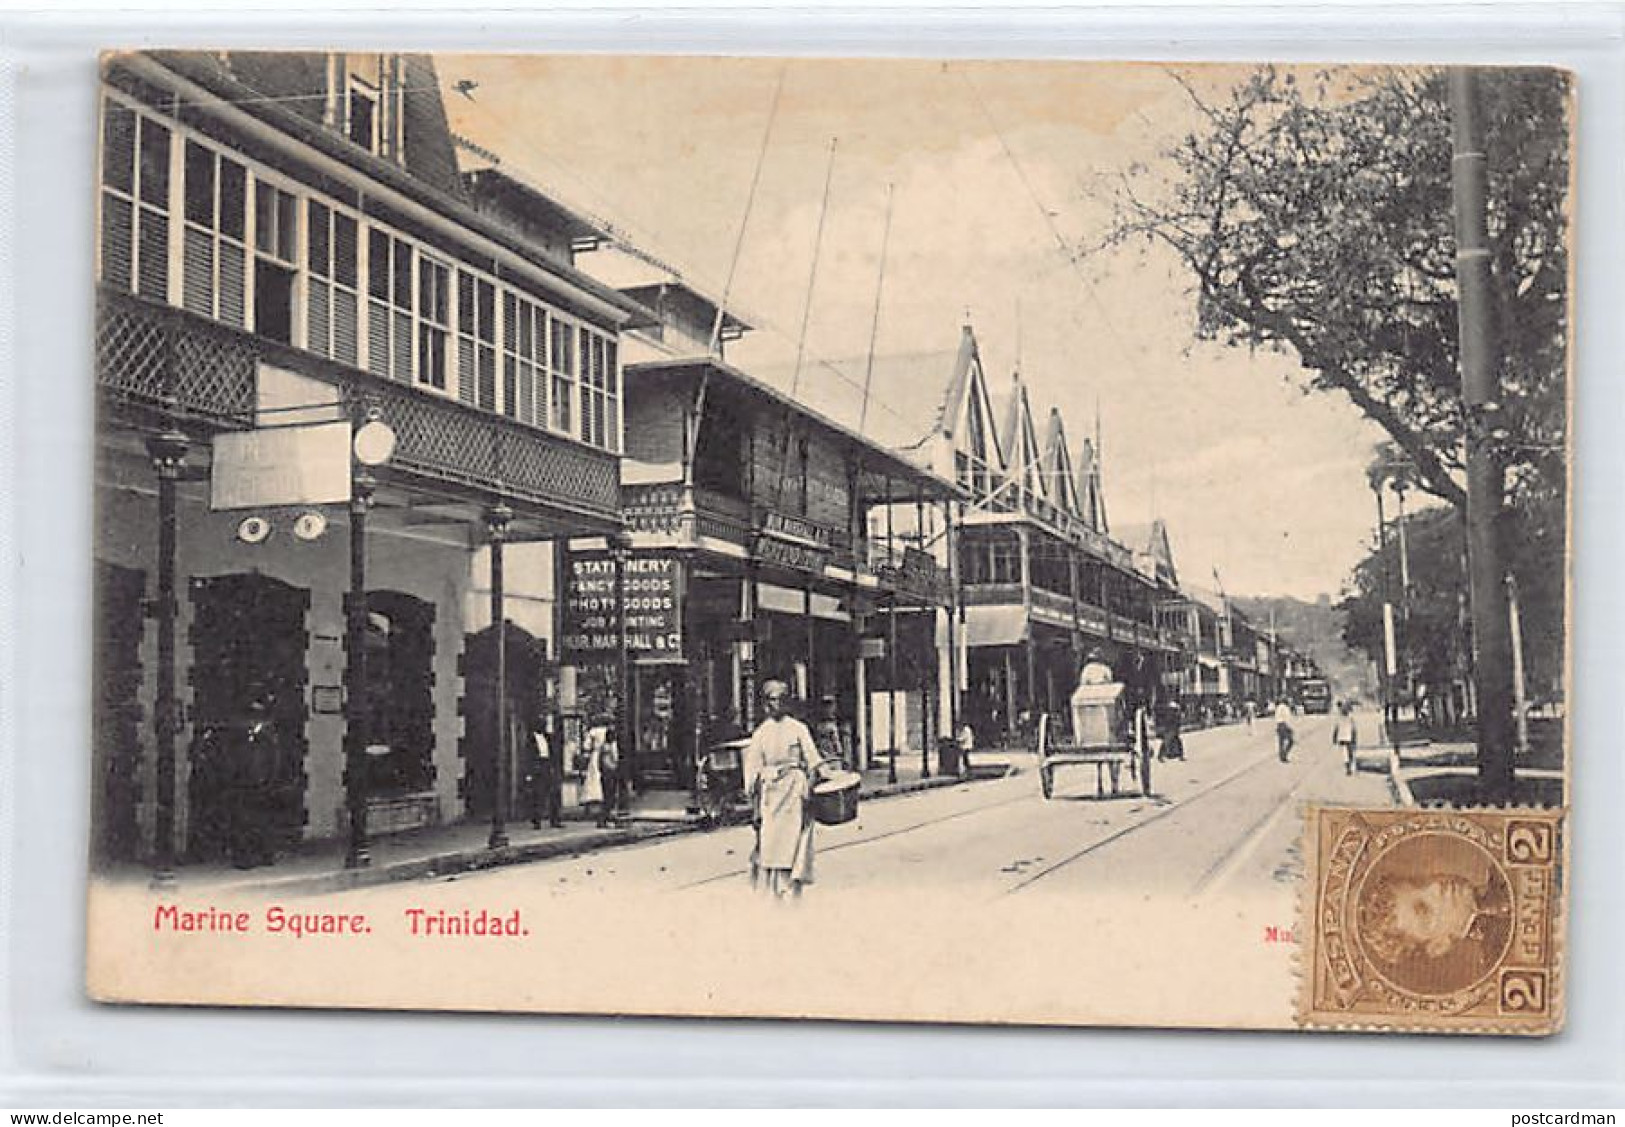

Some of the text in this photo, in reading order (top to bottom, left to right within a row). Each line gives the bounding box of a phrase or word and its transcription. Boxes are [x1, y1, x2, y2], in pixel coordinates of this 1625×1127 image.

[573, 559, 671, 575] STATINERY
[592, 633, 652, 649] MARHALL
[154, 905, 530, 938] Marine Square. Trinidad.
